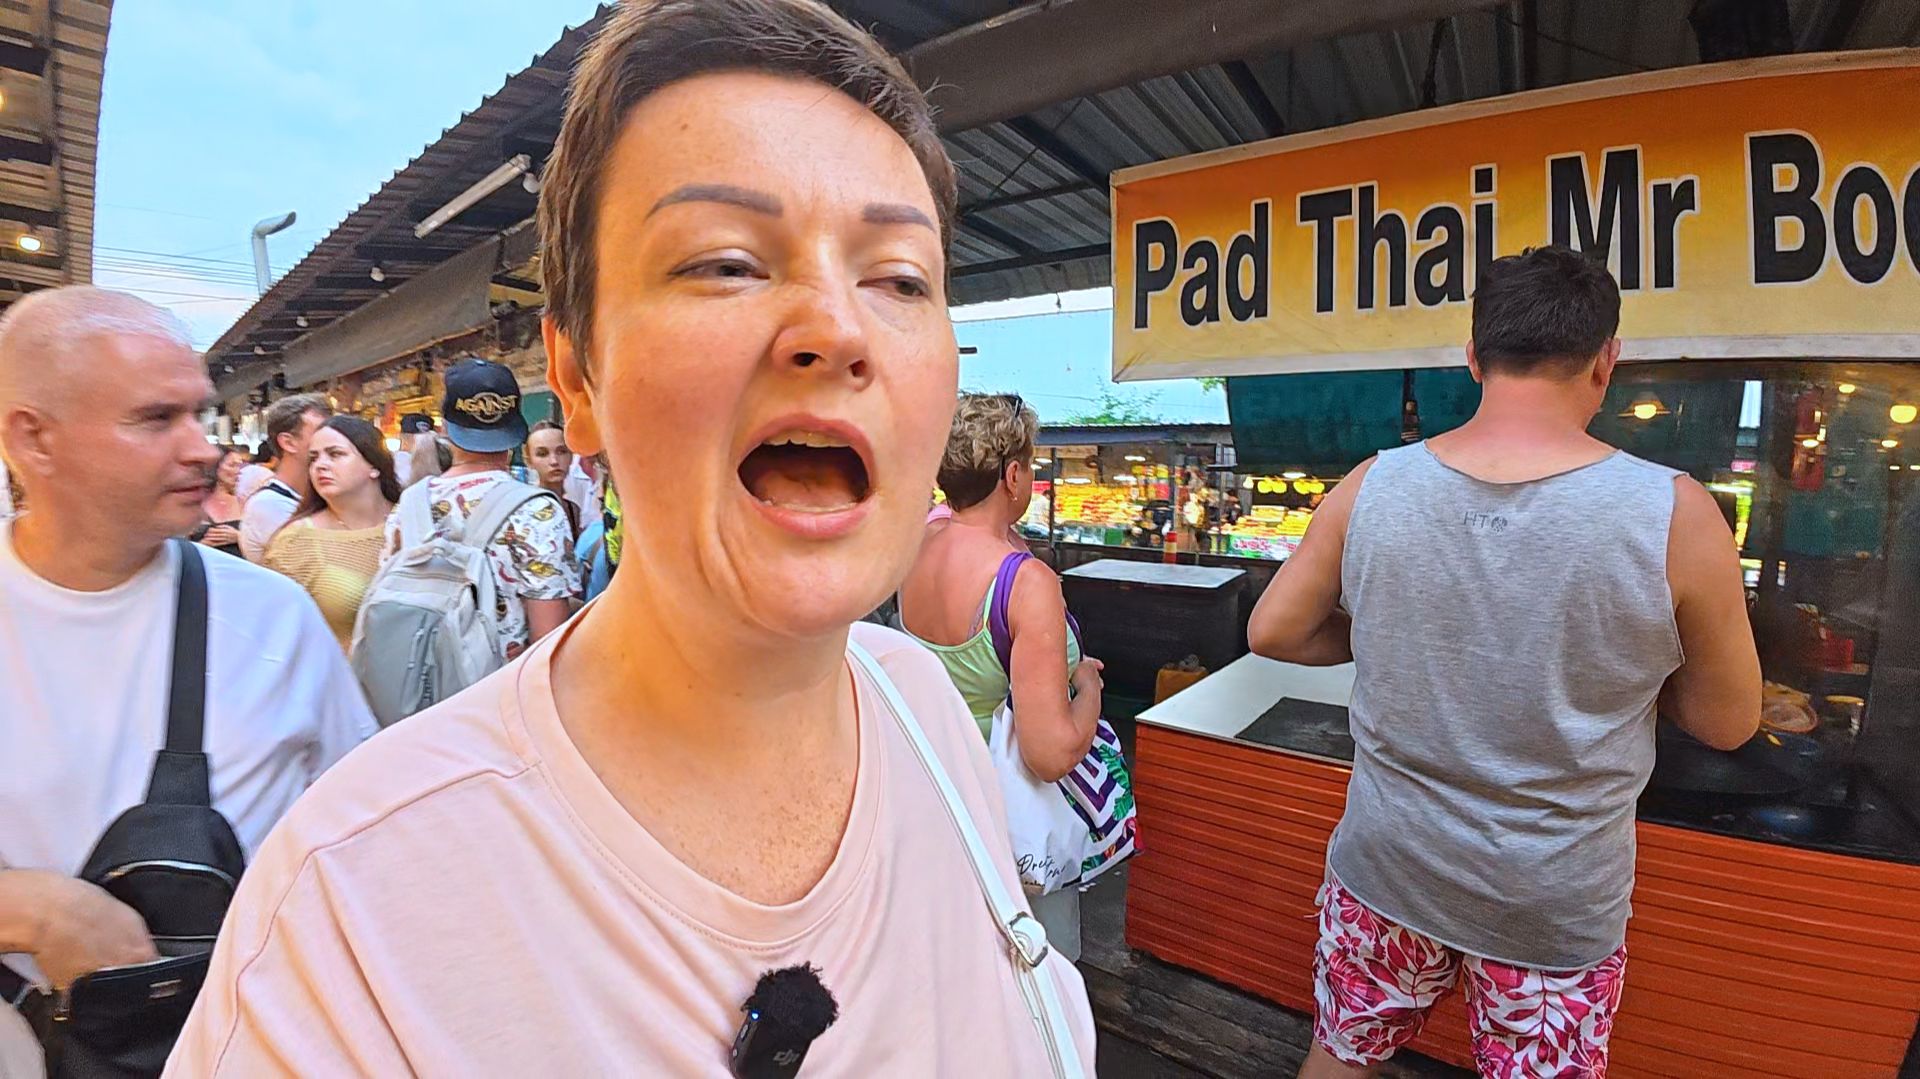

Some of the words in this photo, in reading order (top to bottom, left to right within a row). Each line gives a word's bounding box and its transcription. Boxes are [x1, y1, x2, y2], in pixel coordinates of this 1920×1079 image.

[1134, 201, 1269, 330] Pad
[1299, 168, 1494, 311] Thai
[1550, 149, 1696, 289] Mr
[1748, 133, 1920, 284] Bo
